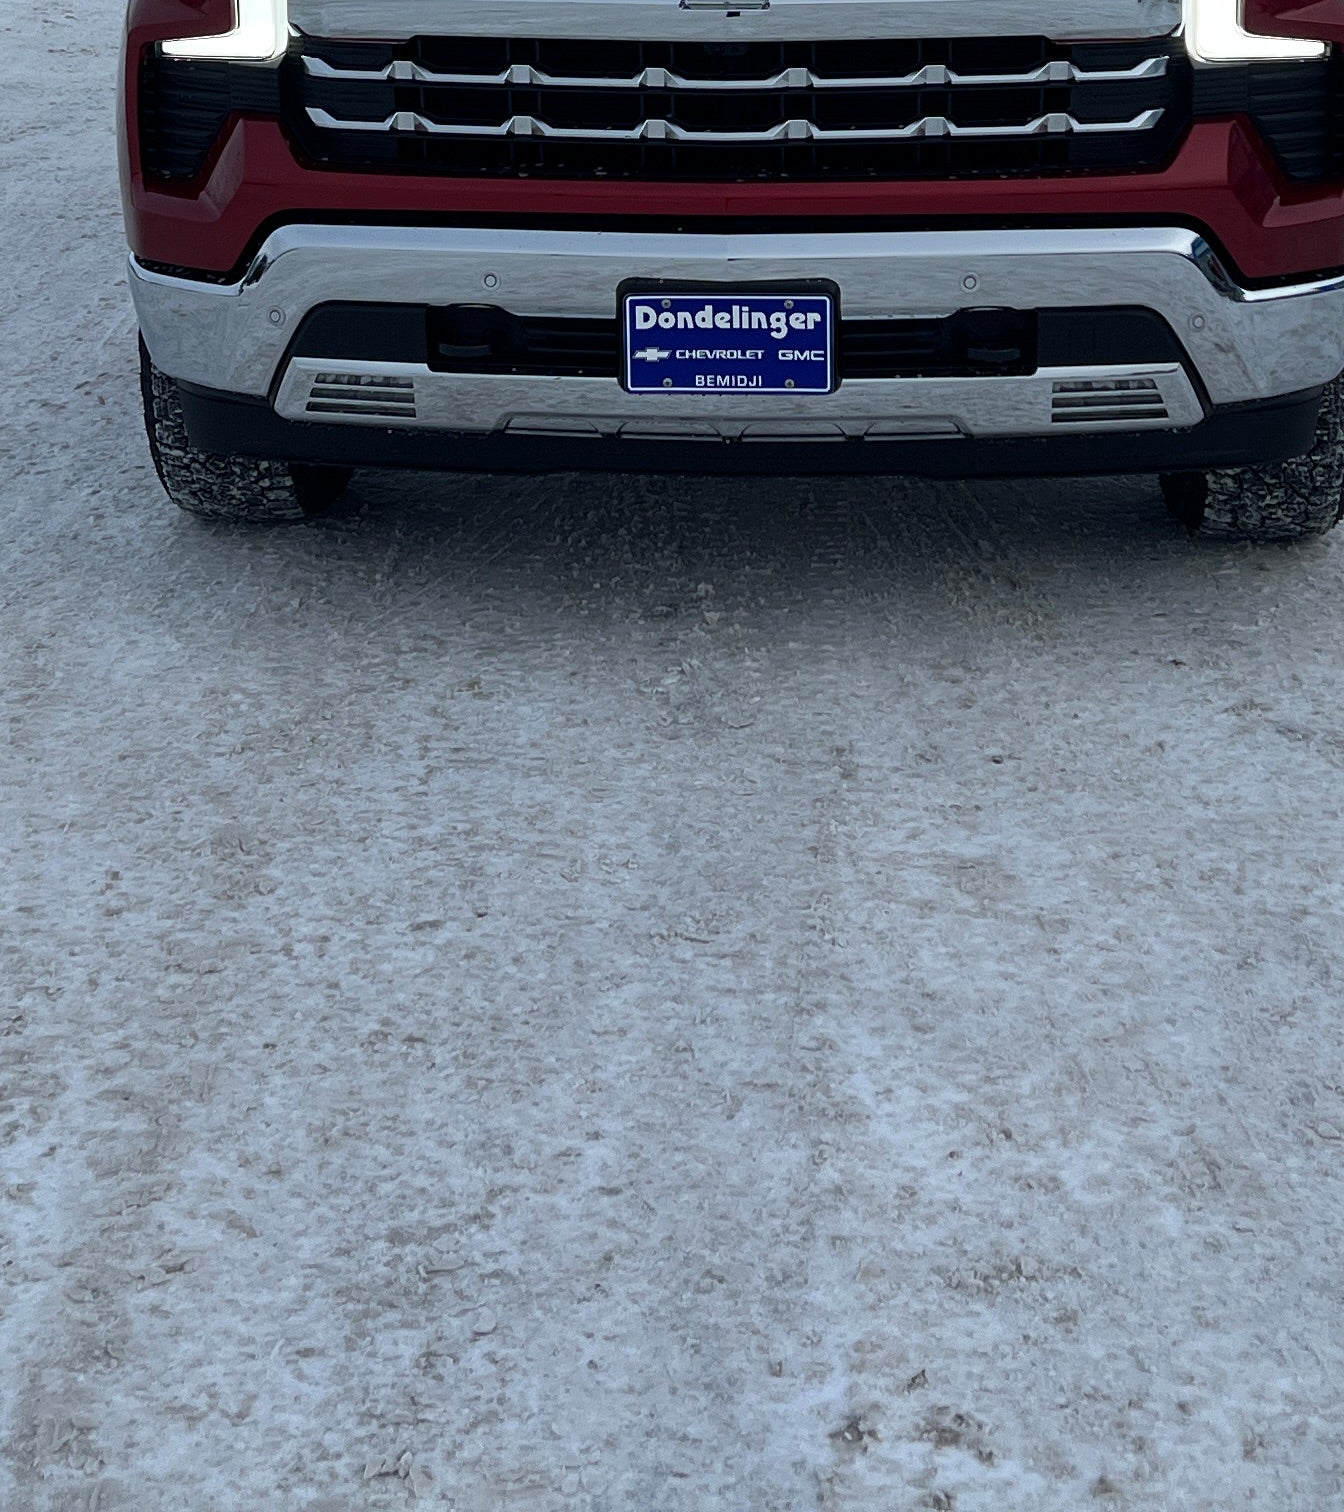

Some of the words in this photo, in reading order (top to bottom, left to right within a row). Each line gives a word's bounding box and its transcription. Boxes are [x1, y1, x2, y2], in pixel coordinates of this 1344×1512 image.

[635, 305, 822, 339] Dondelinger
[675, 349, 765, 360] CHEVROLET
[778, 350, 825, 361] GMC
[695, 375, 763, 387] BEMIDJI
